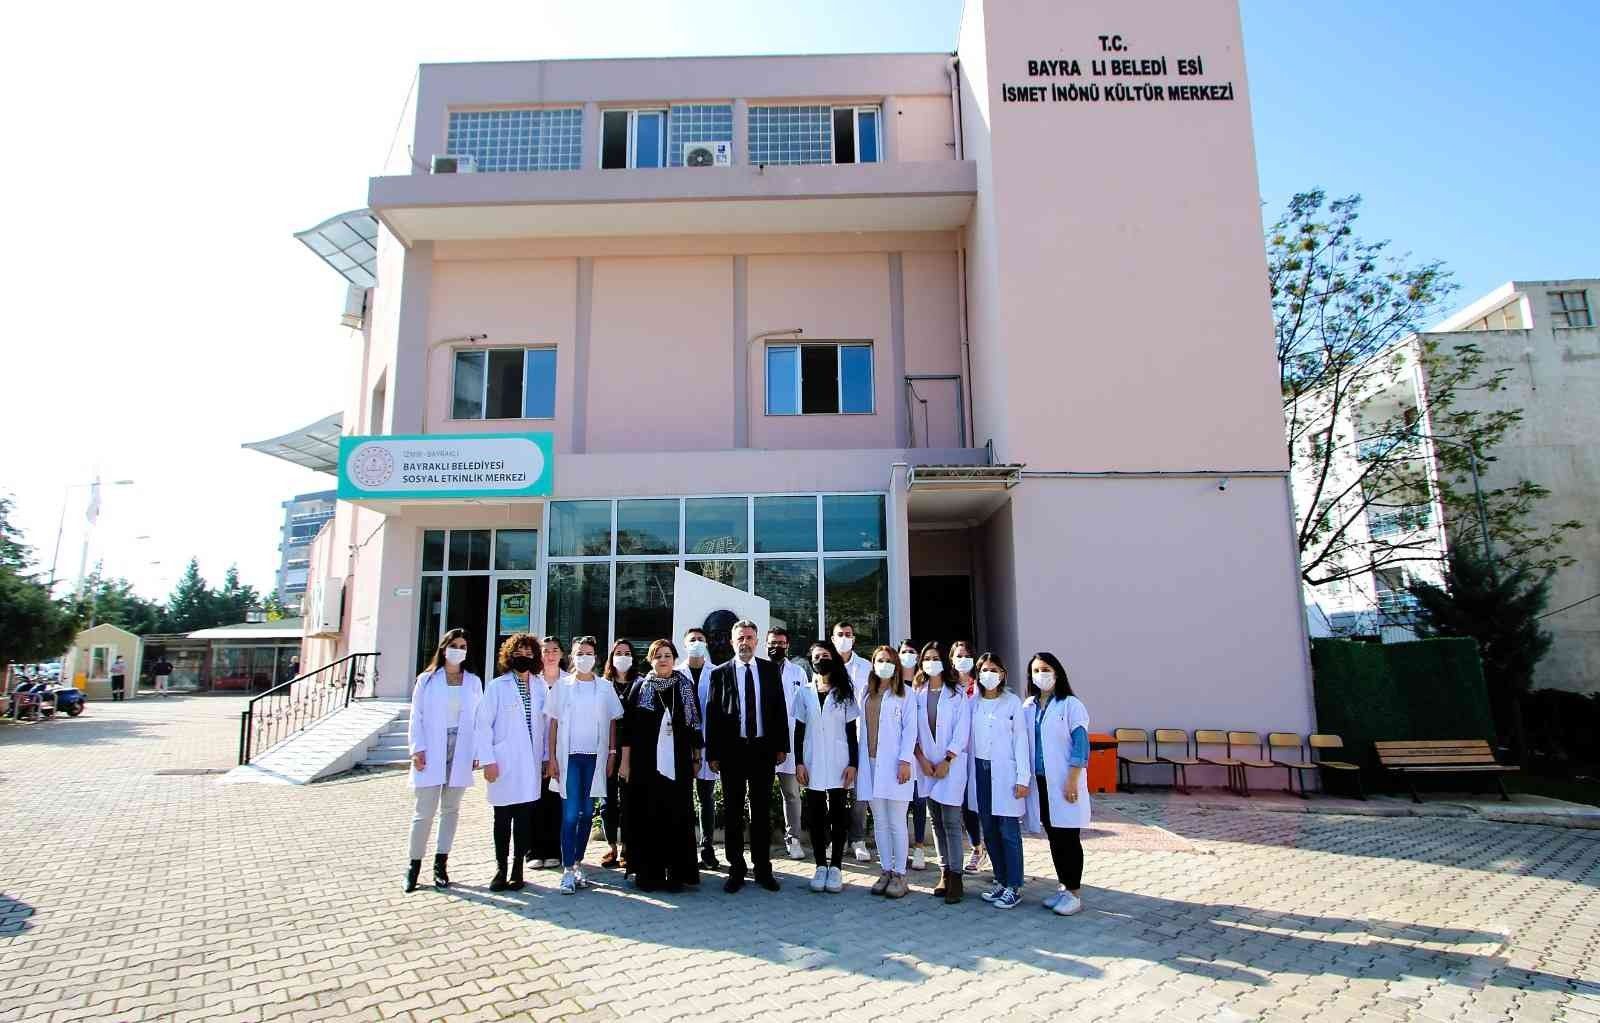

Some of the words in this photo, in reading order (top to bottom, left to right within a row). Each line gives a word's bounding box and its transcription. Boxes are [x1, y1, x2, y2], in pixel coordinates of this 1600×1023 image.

[1098, 35, 1128, 52] T.C.
[1002, 83, 1047, 102] İSMET
[1052, 83, 1099, 102] İNÖNÜ
[1104, 83, 1164, 101] KÜLTÜR
[1168, 82, 1234, 101] MERKEZİ
[403, 462, 450, 471] BAYRAKLI
[452, 460, 504, 470] BELEDİYESİ
[402, 474, 439, 483] SOSYAL
[441, 473, 483, 482] ETKİNLİK
[485, 472, 526, 482] MERKEZİ
